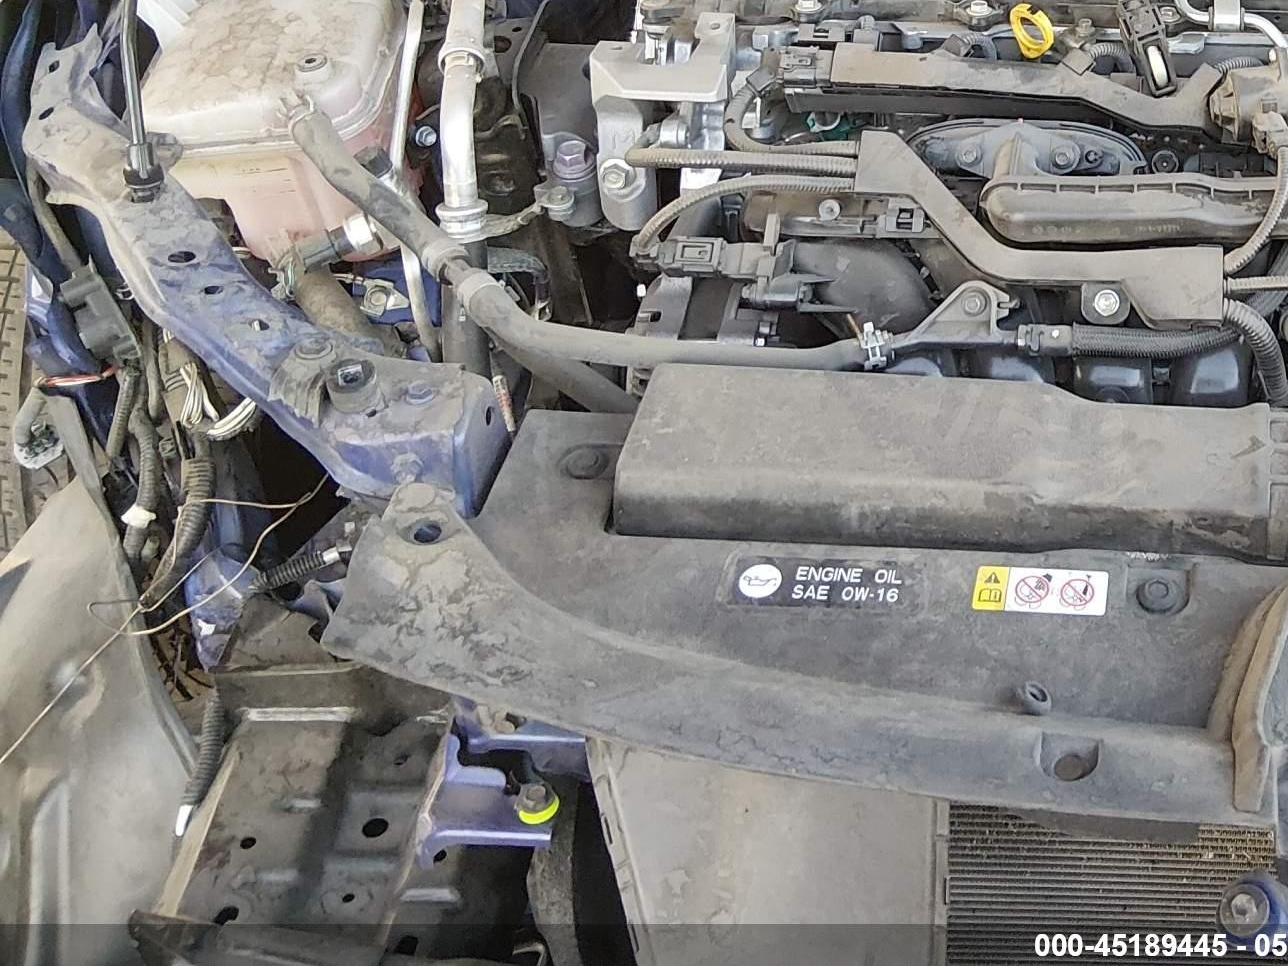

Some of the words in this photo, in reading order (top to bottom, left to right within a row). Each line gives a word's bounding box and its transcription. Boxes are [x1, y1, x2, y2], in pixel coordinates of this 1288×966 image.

[796, 566, 863, 582] ENGINE
[875, 569, 902, 584] OIL
[792, 585, 830, 600] SAE
[842, 587, 899, 602] 0W-16
